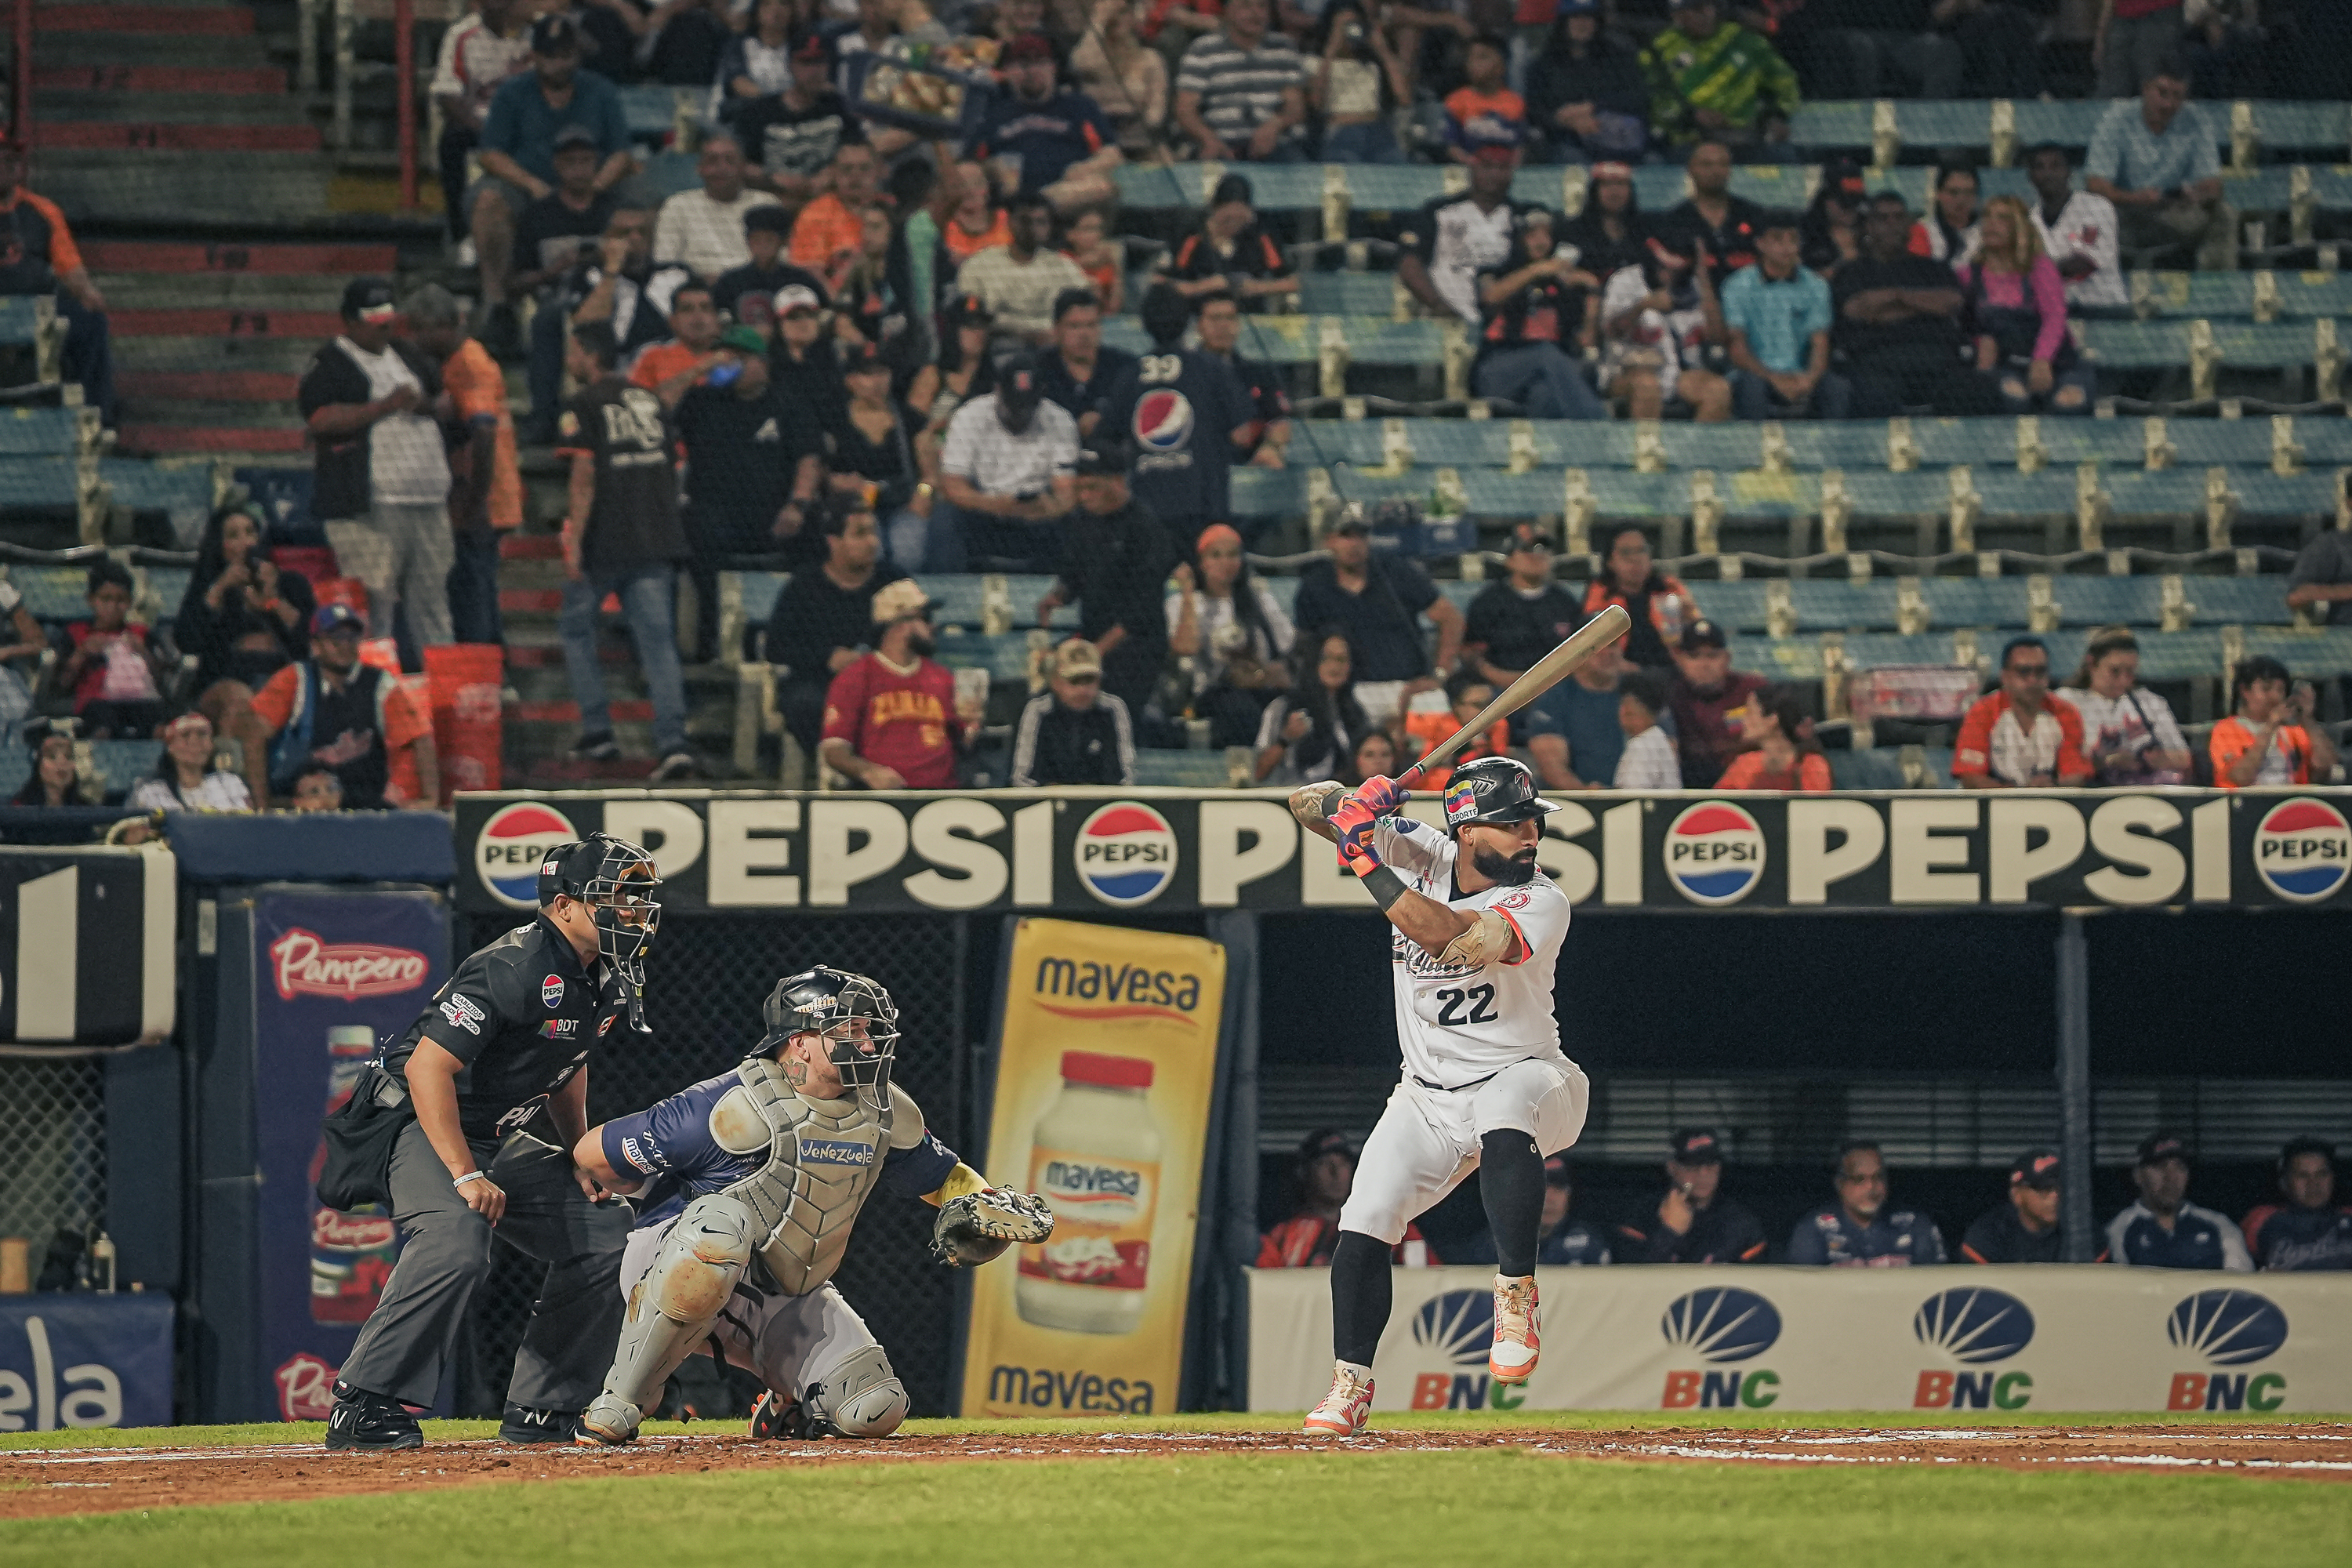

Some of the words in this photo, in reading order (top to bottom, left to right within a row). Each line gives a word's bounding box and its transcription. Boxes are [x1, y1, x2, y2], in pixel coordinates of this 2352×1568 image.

[1450, 808, 1478, 823] DEPORTE
[603, 798, 1054, 909] PEPSI
[1084, 842, 1169, 863] PEPSI
[1673, 841, 1759, 862] PEPSI
[1787, 796, 2232, 906] PEPSI
[2261, 838, 2348, 859] PEPSI
[276, 931, 424, 992] Pampero
[543, 986, 563, 996] PEPSI
[1036, 956, 1201, 1011] mavesa
[1436, 982, 1499, 1026] 22
[557, 1018, 579, 1033] BDT
[626, 1138, 658, 1174] mavesa
[1046, 1161, 1141, 1196] mavesa
[989, 1364, 1155, 1414] mavesa
[1410, 1371, 1527, 1410] BNC
[1661, 1370, 1781, 1409] BNC
[1913, 1370, 2034, 1410] BNC
[2166, 1372, 2287, 1410] BNC
